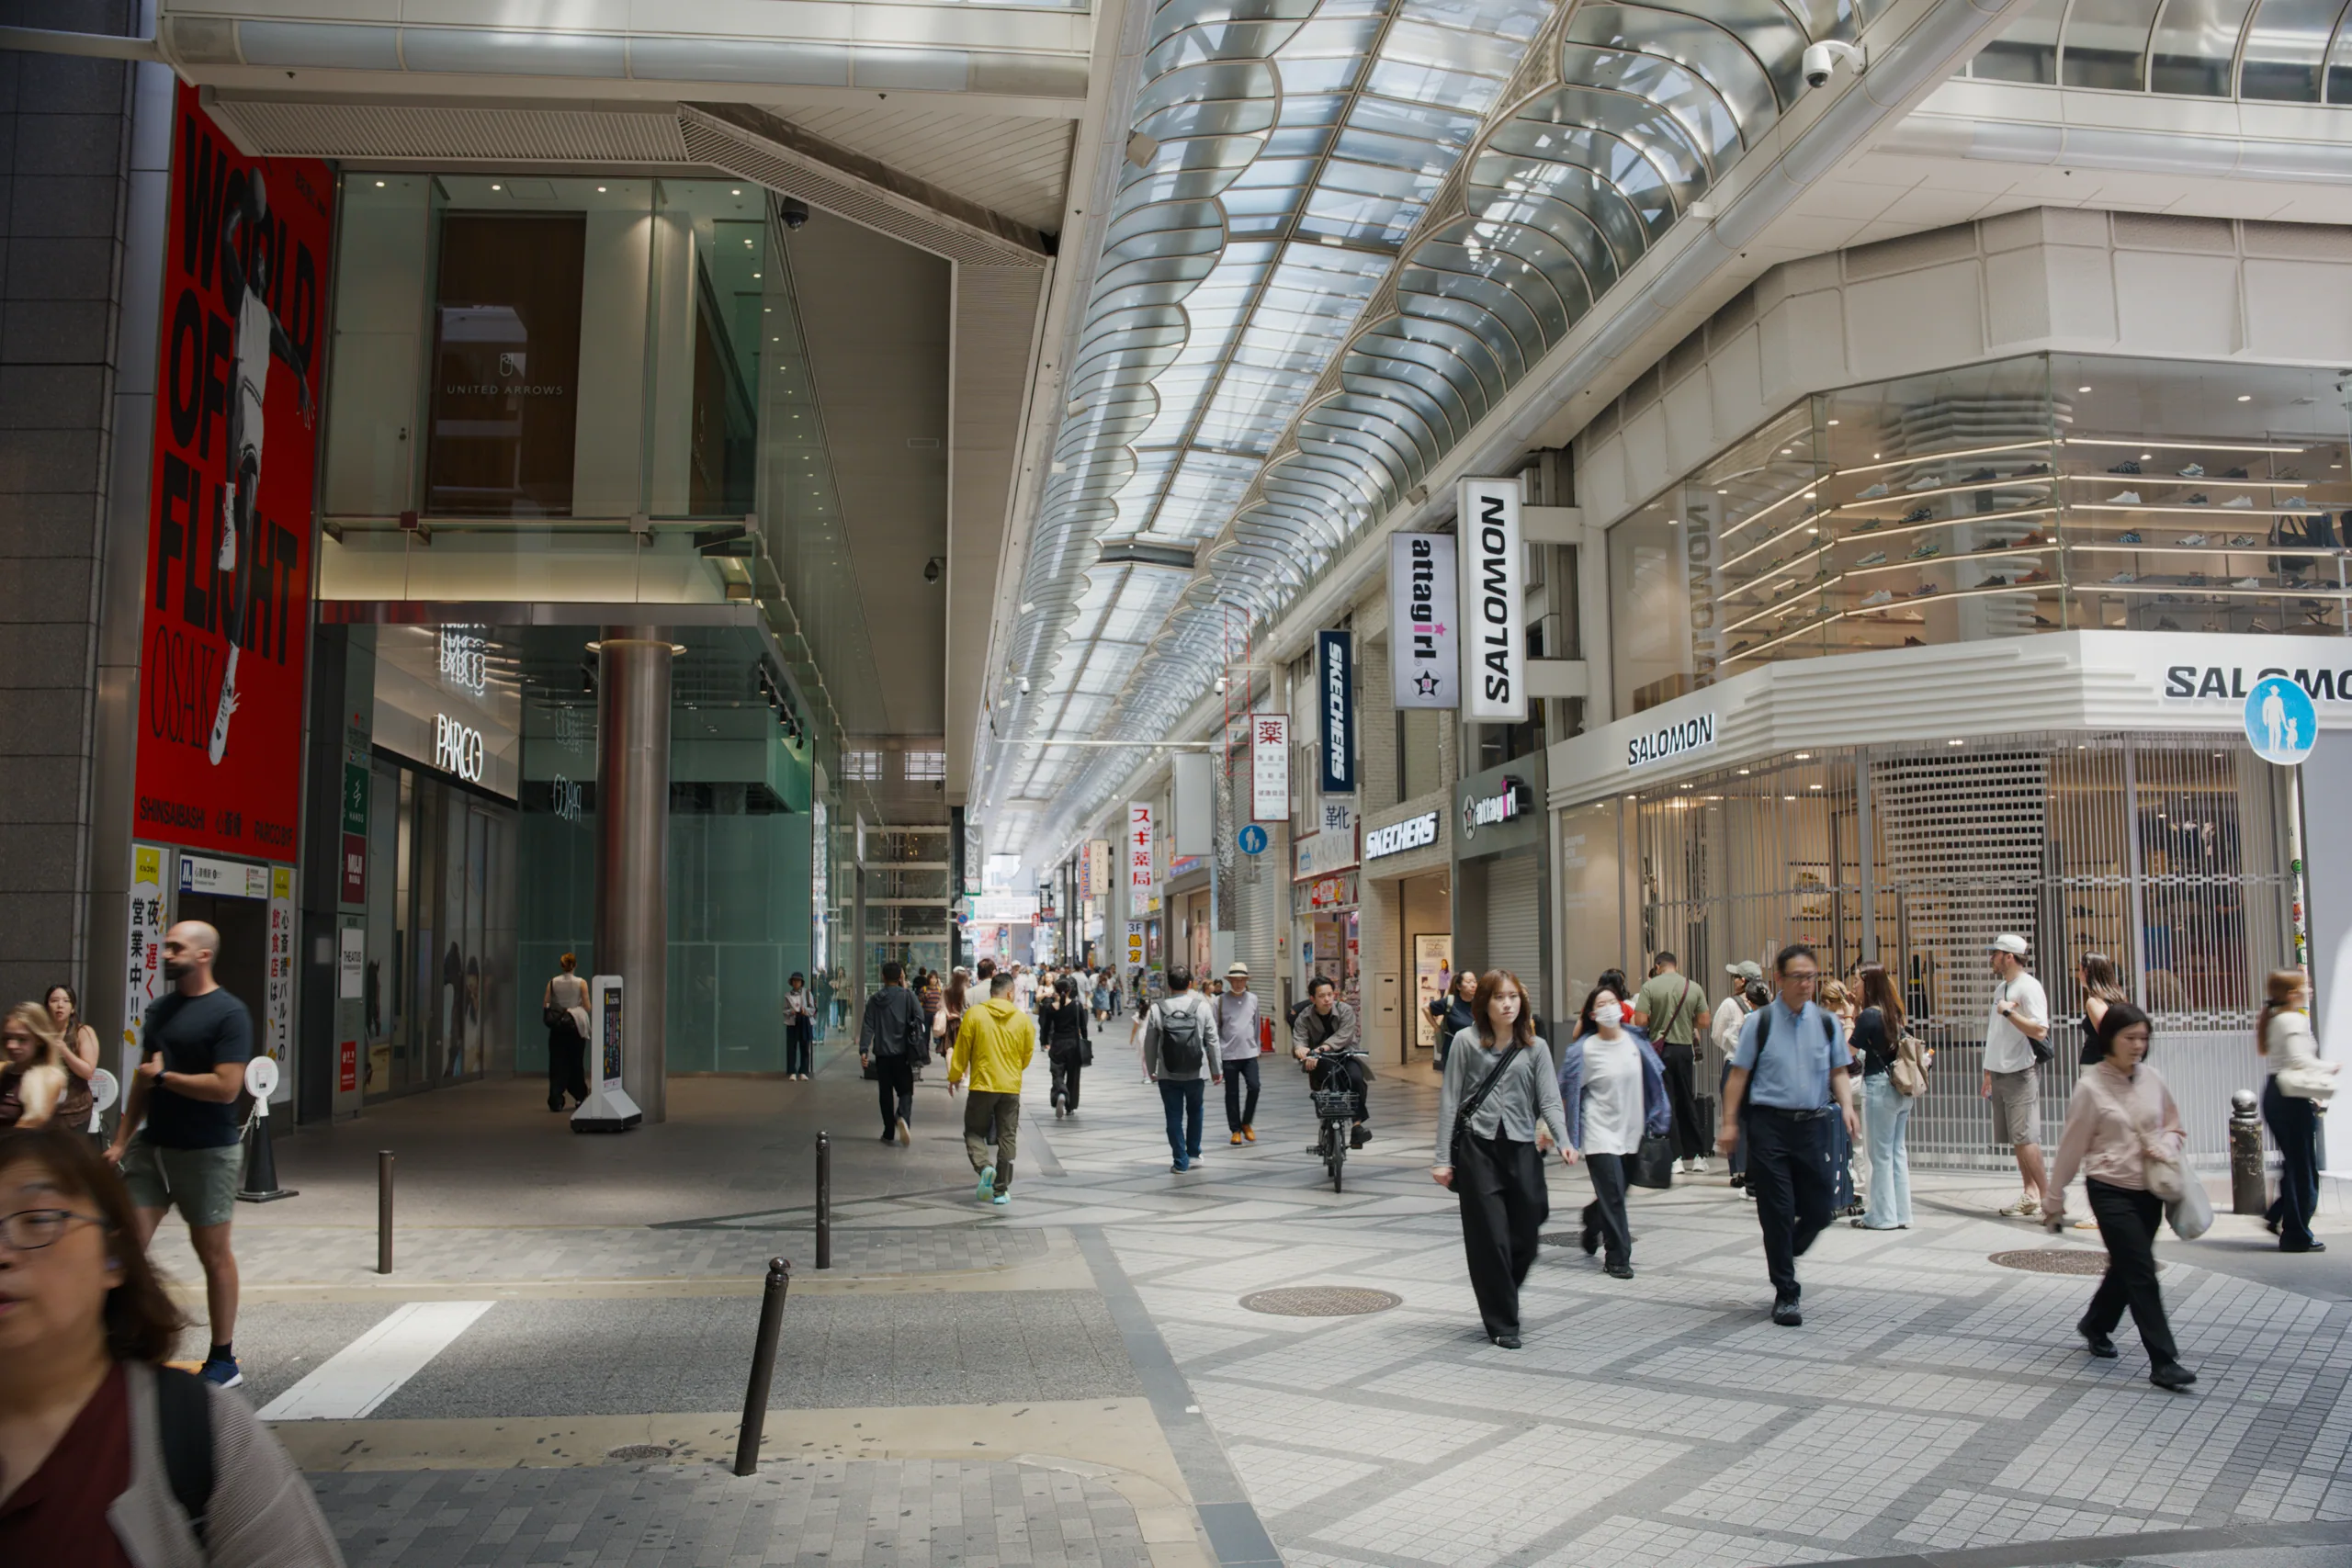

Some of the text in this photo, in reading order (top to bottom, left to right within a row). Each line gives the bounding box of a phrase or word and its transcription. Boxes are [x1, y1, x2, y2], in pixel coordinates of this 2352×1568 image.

[185, 110, 317, 378] WORLD
[171, 288, 232, 462] OF
[447, 385, 563, 396] UNITED ARROWS
[1410, 539, 1443, 659] attagirl
[1481, 495, 1510, 704] SALOMON
[151, 625, 229, 757] OSAK
[2165, 666, 2352, 700] SALM
[1259, 721, 1283, 745] 薬
[1329, 640, 1345, 782] SKECHERS
[435, 713, 483, 782] PARCO
[1628, 714, 1713, 765] SALOMON
[140, 795, 205, 831] SHINSAIBASHI
[348, 810, 365, 824] HANDS
[1326, 805, 1350, 830] 靴
[1476, 776, 1516, 825] attagirl
[1132, 809, 1151, 886] スギ薬局
[1365, 812, 1436, 860] SKECHERS
[347, 853, 363, 874] MUJI
[966, 845, 978, 878] asics
[1128, 923, 1142, 932] 3F
